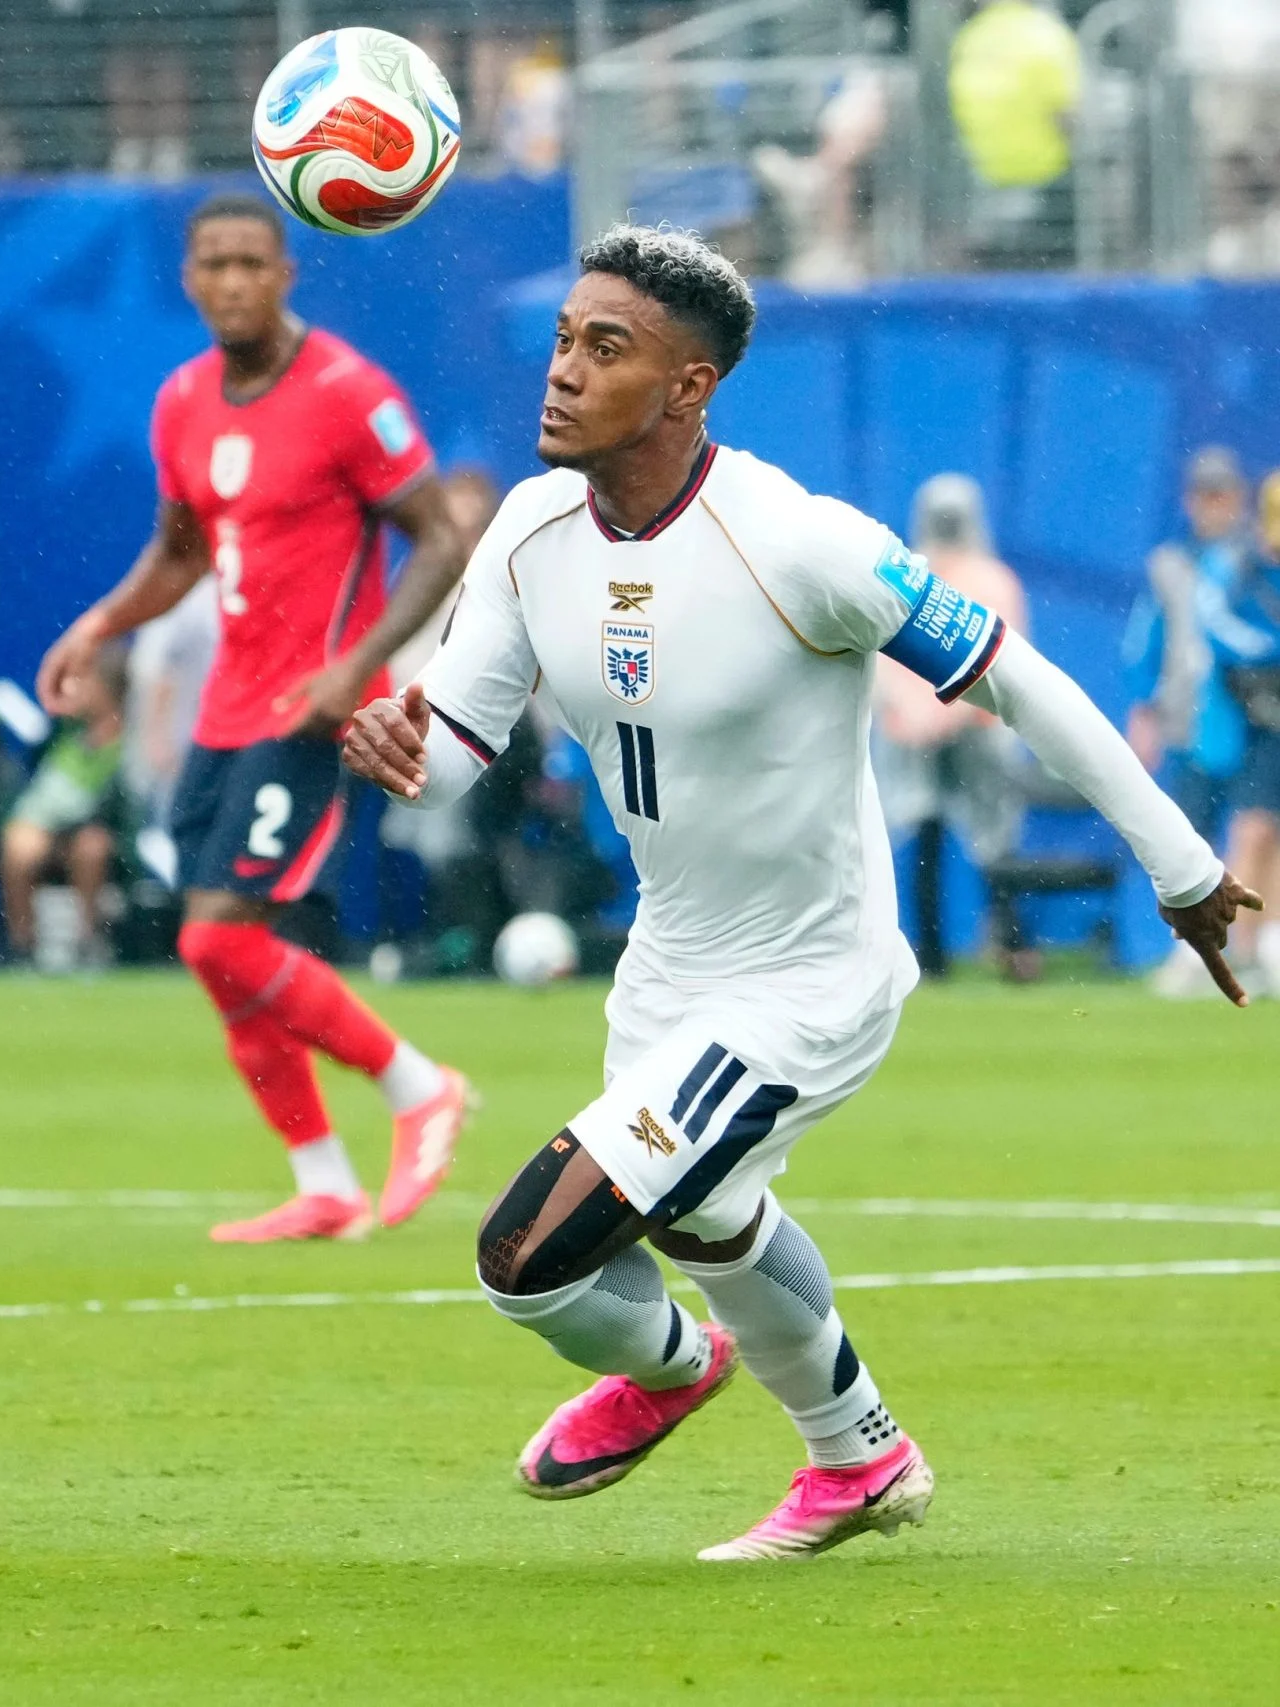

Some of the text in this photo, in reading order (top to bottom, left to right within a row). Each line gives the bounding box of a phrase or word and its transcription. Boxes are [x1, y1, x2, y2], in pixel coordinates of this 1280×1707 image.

[608, 581, 653, 594] Reebok
[940, 627, 960, 651] the
[615, 720, 660, 823] 11
[247, 783, 293, 859] 2
[668, 1041, 749, 1145] 11
[637, 1106, 677, 1154] Reebok
